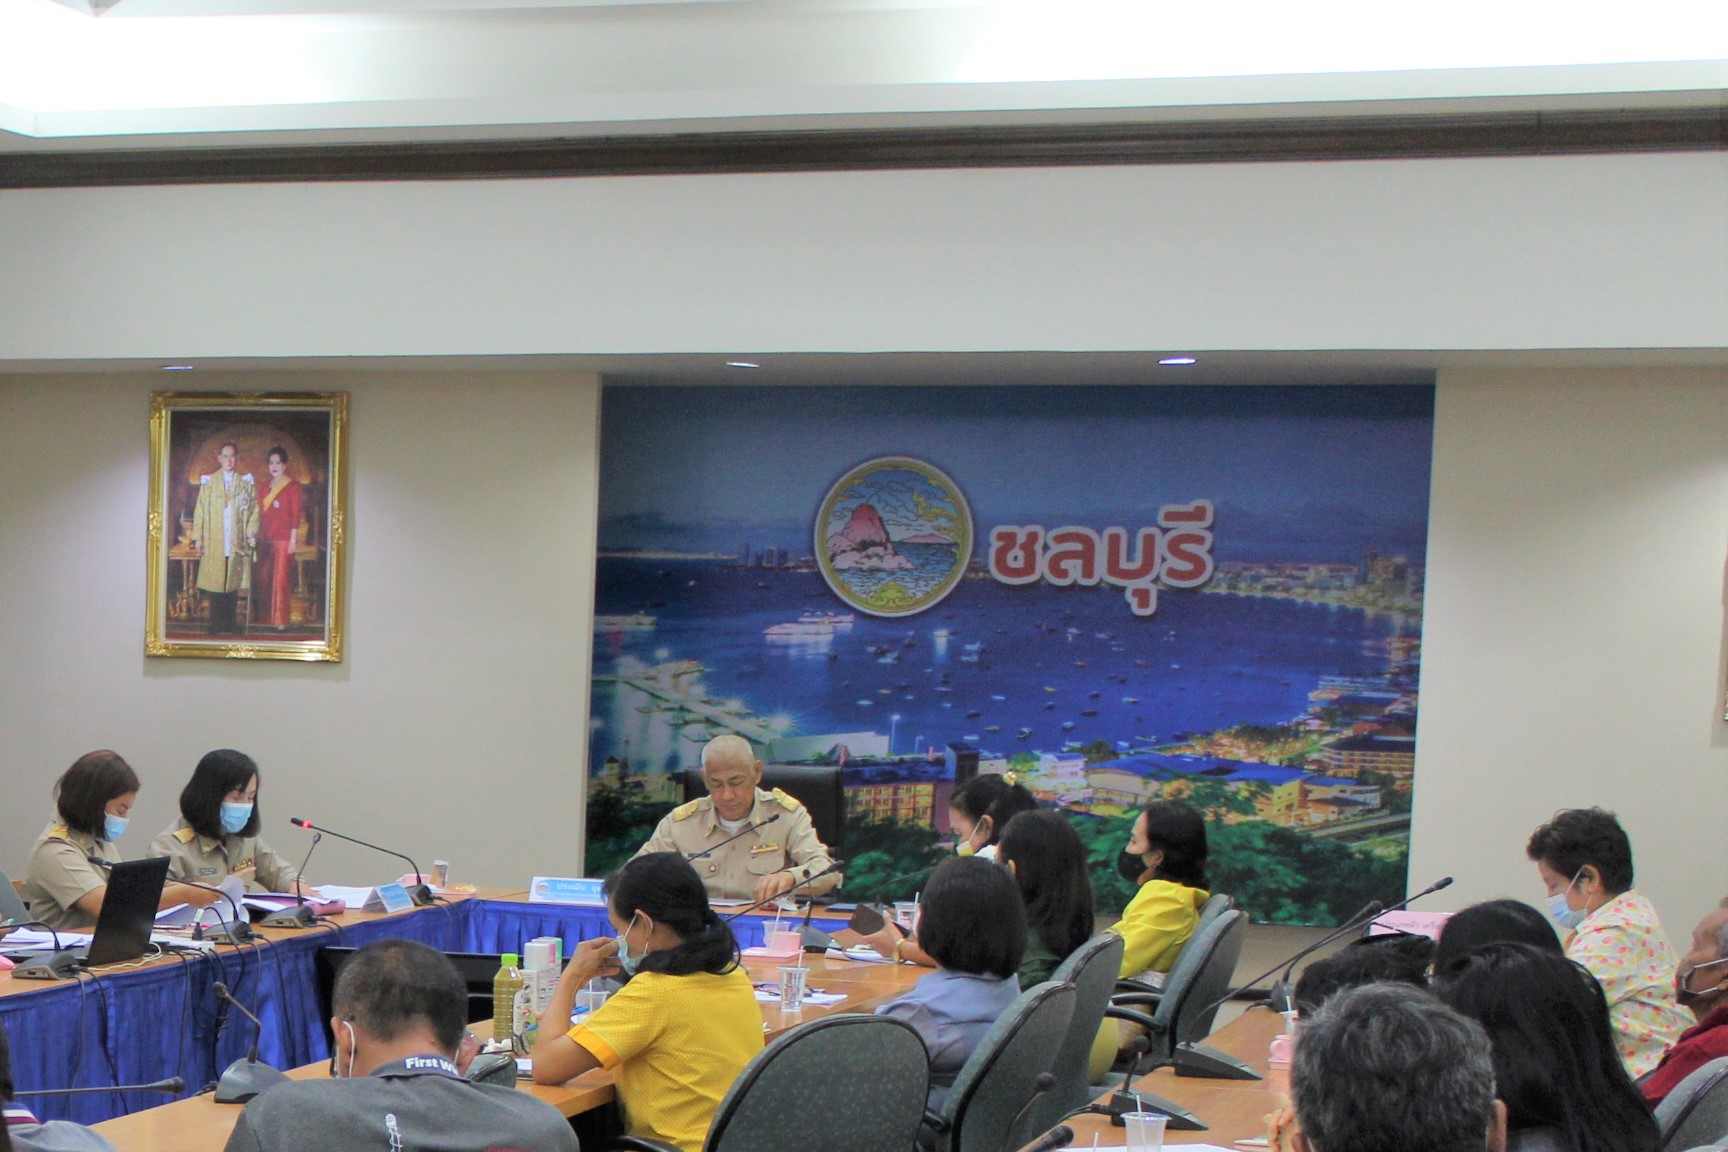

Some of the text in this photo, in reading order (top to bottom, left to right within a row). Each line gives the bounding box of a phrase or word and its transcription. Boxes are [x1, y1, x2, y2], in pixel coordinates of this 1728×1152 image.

[991, 501, 1211, 613] ชลบุรี
[405, 1057, 439, 1070] First
